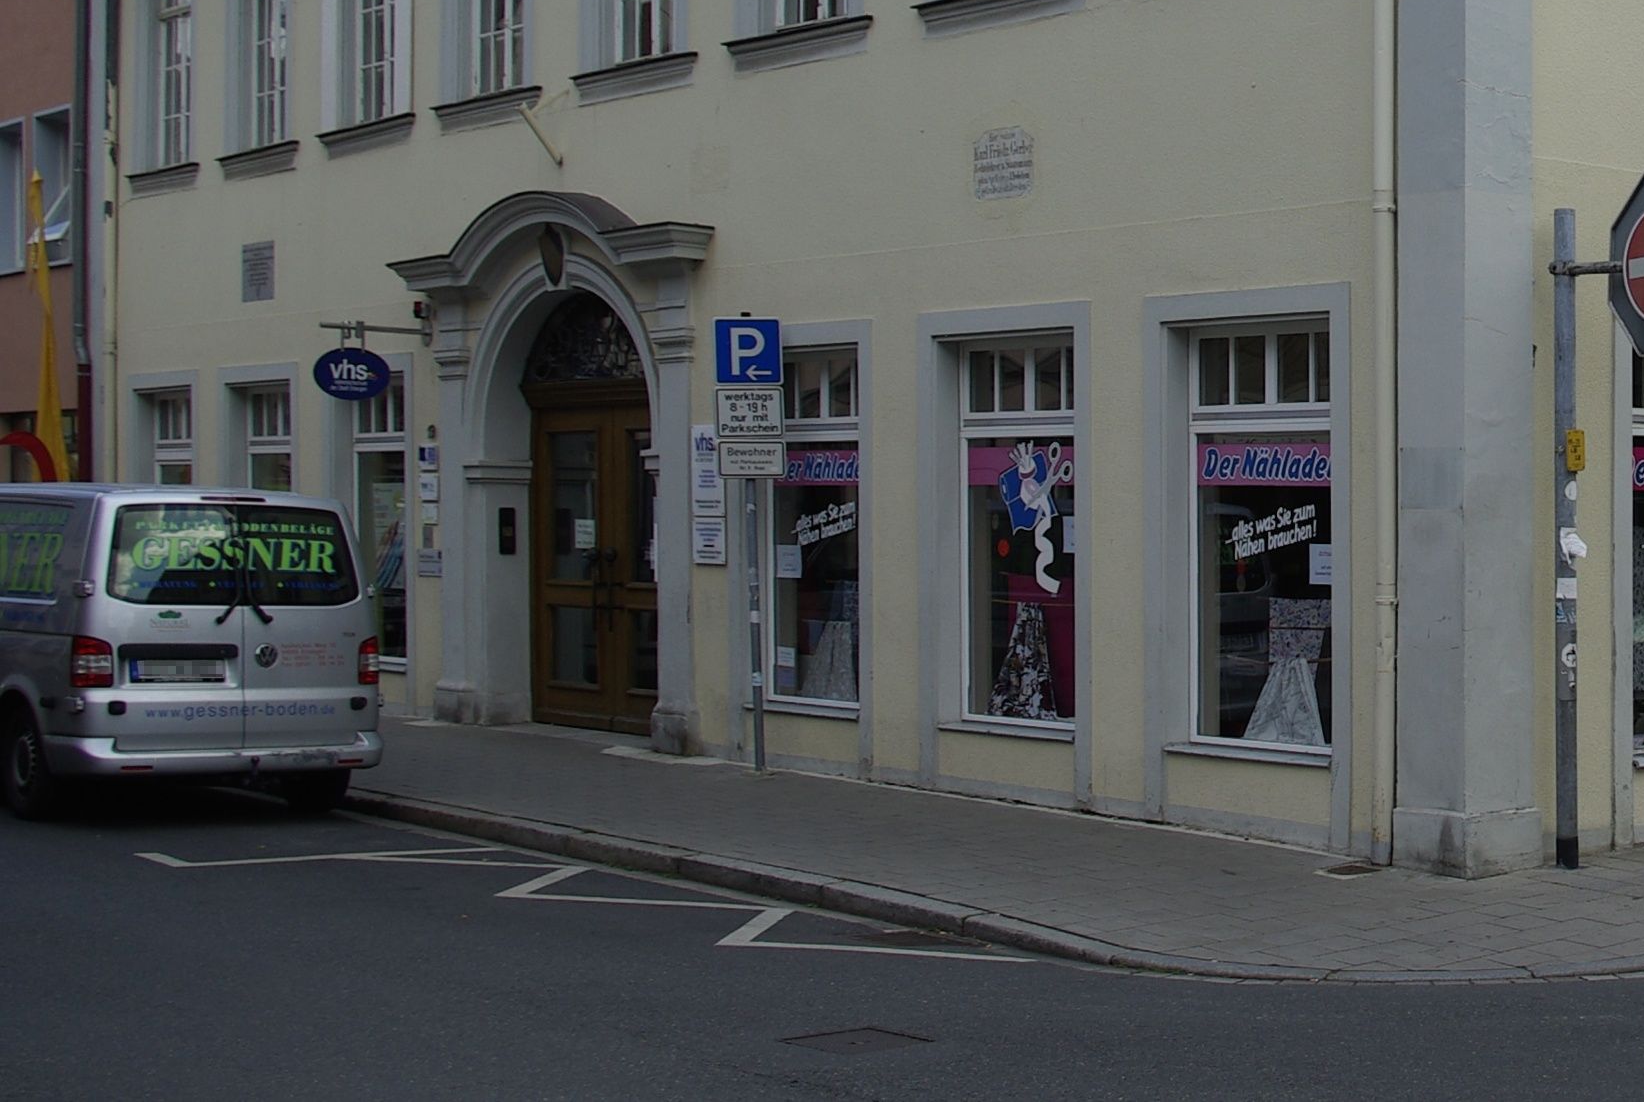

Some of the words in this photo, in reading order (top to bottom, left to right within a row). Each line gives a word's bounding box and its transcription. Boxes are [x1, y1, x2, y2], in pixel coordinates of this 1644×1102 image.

[729, 326, 766, 376] P
[329, 358, 369, 380] vhs
[724, 391, 774, 404] werktags
[721, 421, 779, 434] Parkschein
[730, 412, 747, 423] nur
[752, 411, 769, 423] mit
[694, 433, 713, 451] vhs
[726, 446, 778, 457] Bewohner
[1202, 447, 1243, 480] Der
[1240, 447, 1331, 482] Nählade
[1255, 514, 1276, 534] was
[1276, 506, 1292, 528] Sie
[1292, 503, 1315, 523] zum
[1234, 537, 1265, 560] Nähen
[1268, 520, 1317, 550] brauchen!
[131, 535, 337, 575] GESSNER
[144, 701, 336, 721] www.gessner-boden.de
